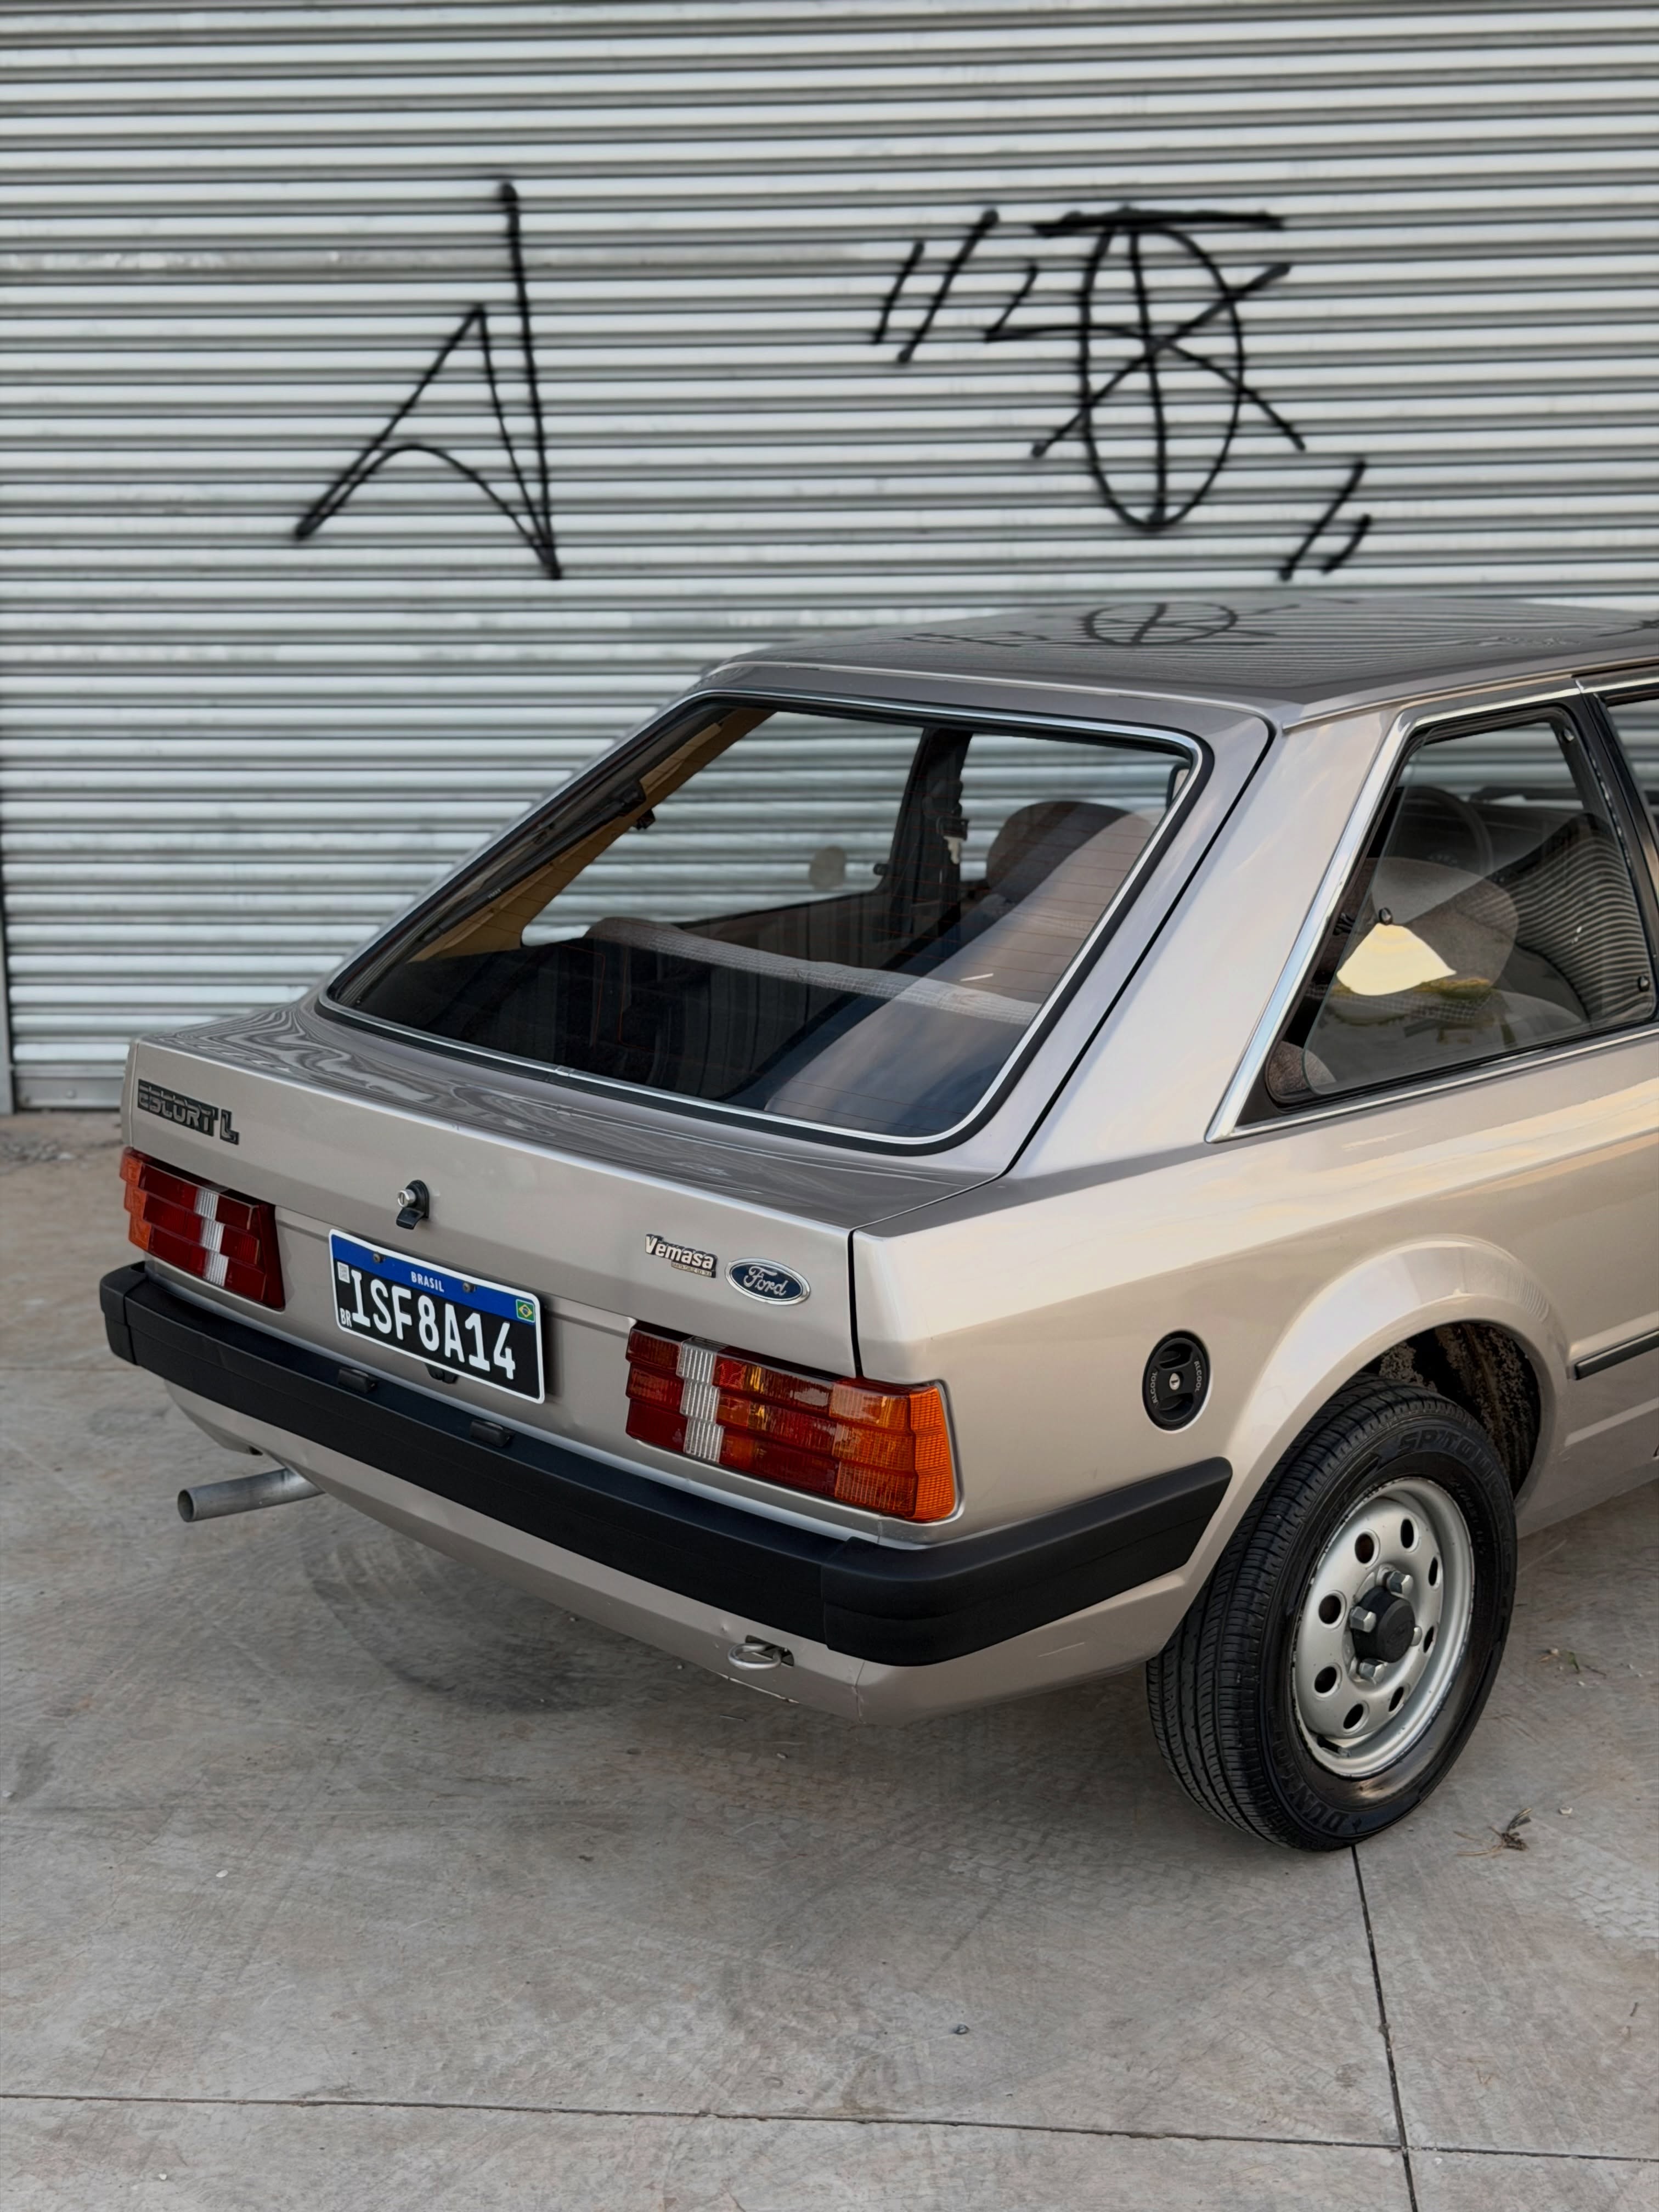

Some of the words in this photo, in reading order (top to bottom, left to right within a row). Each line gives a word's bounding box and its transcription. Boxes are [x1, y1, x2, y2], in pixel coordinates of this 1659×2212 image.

[138, 1081, 216, 1134] ESCORT
[221, 1110, 238, 1143] L
[645, 1235, 715, 1270] Vemasa
[410, 1271, 444, 1293] BRASIL
[743, 1265, 789, 1296] Ford
[339, 1307, 352, 1328] BR
[351, 1269, 516, 1380] ISF8A14
[1194, 1360, 1203, 1393] ALCOOL
